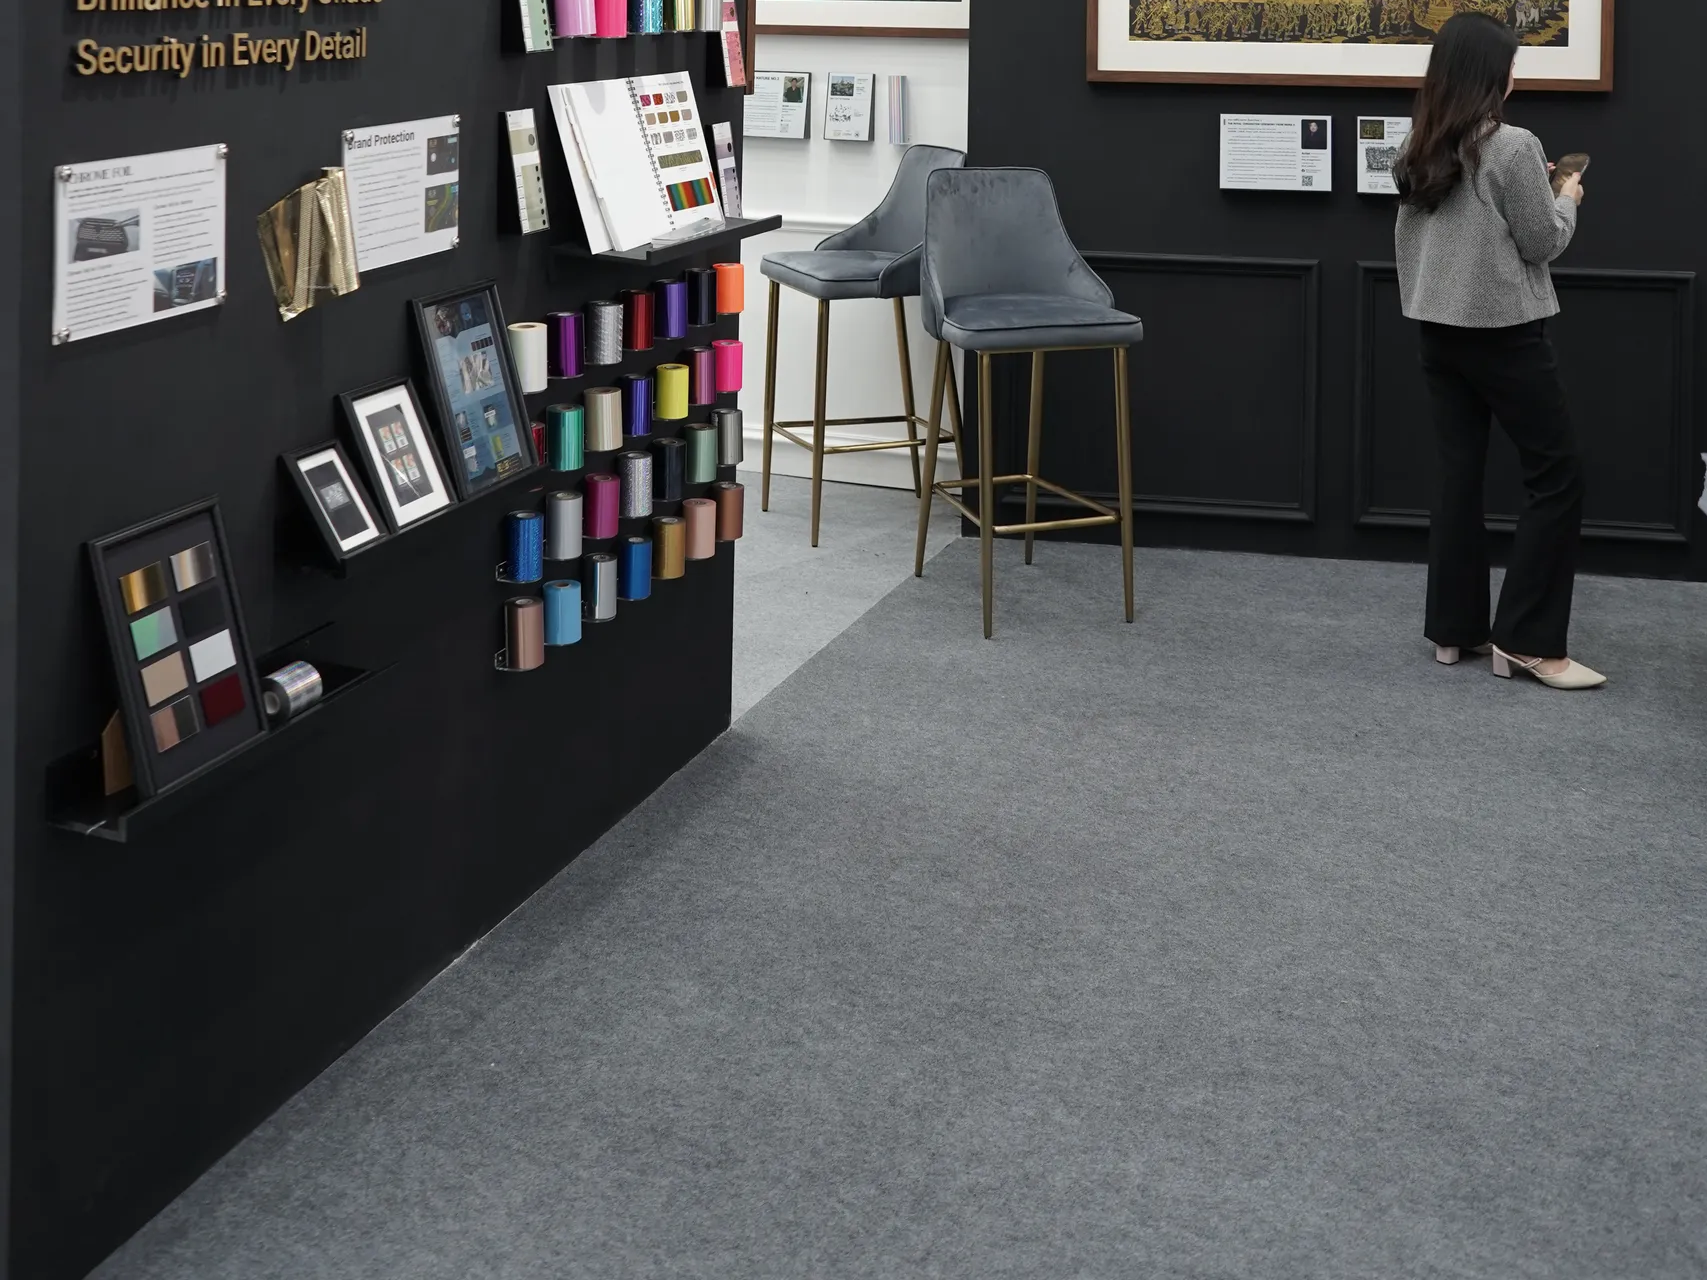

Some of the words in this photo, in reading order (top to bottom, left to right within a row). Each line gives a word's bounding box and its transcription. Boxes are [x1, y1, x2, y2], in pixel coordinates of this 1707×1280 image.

[76, 38, 196, 78] Security
[202, 33, 226, 68] in
[233, 32, 300, 71] Every
[305, 26, 367, 61] Detail
[347, 135, 372, 150] Brand
[374, 130, 415, 147] Protection
[112, 166, 134, 178] FOIL
